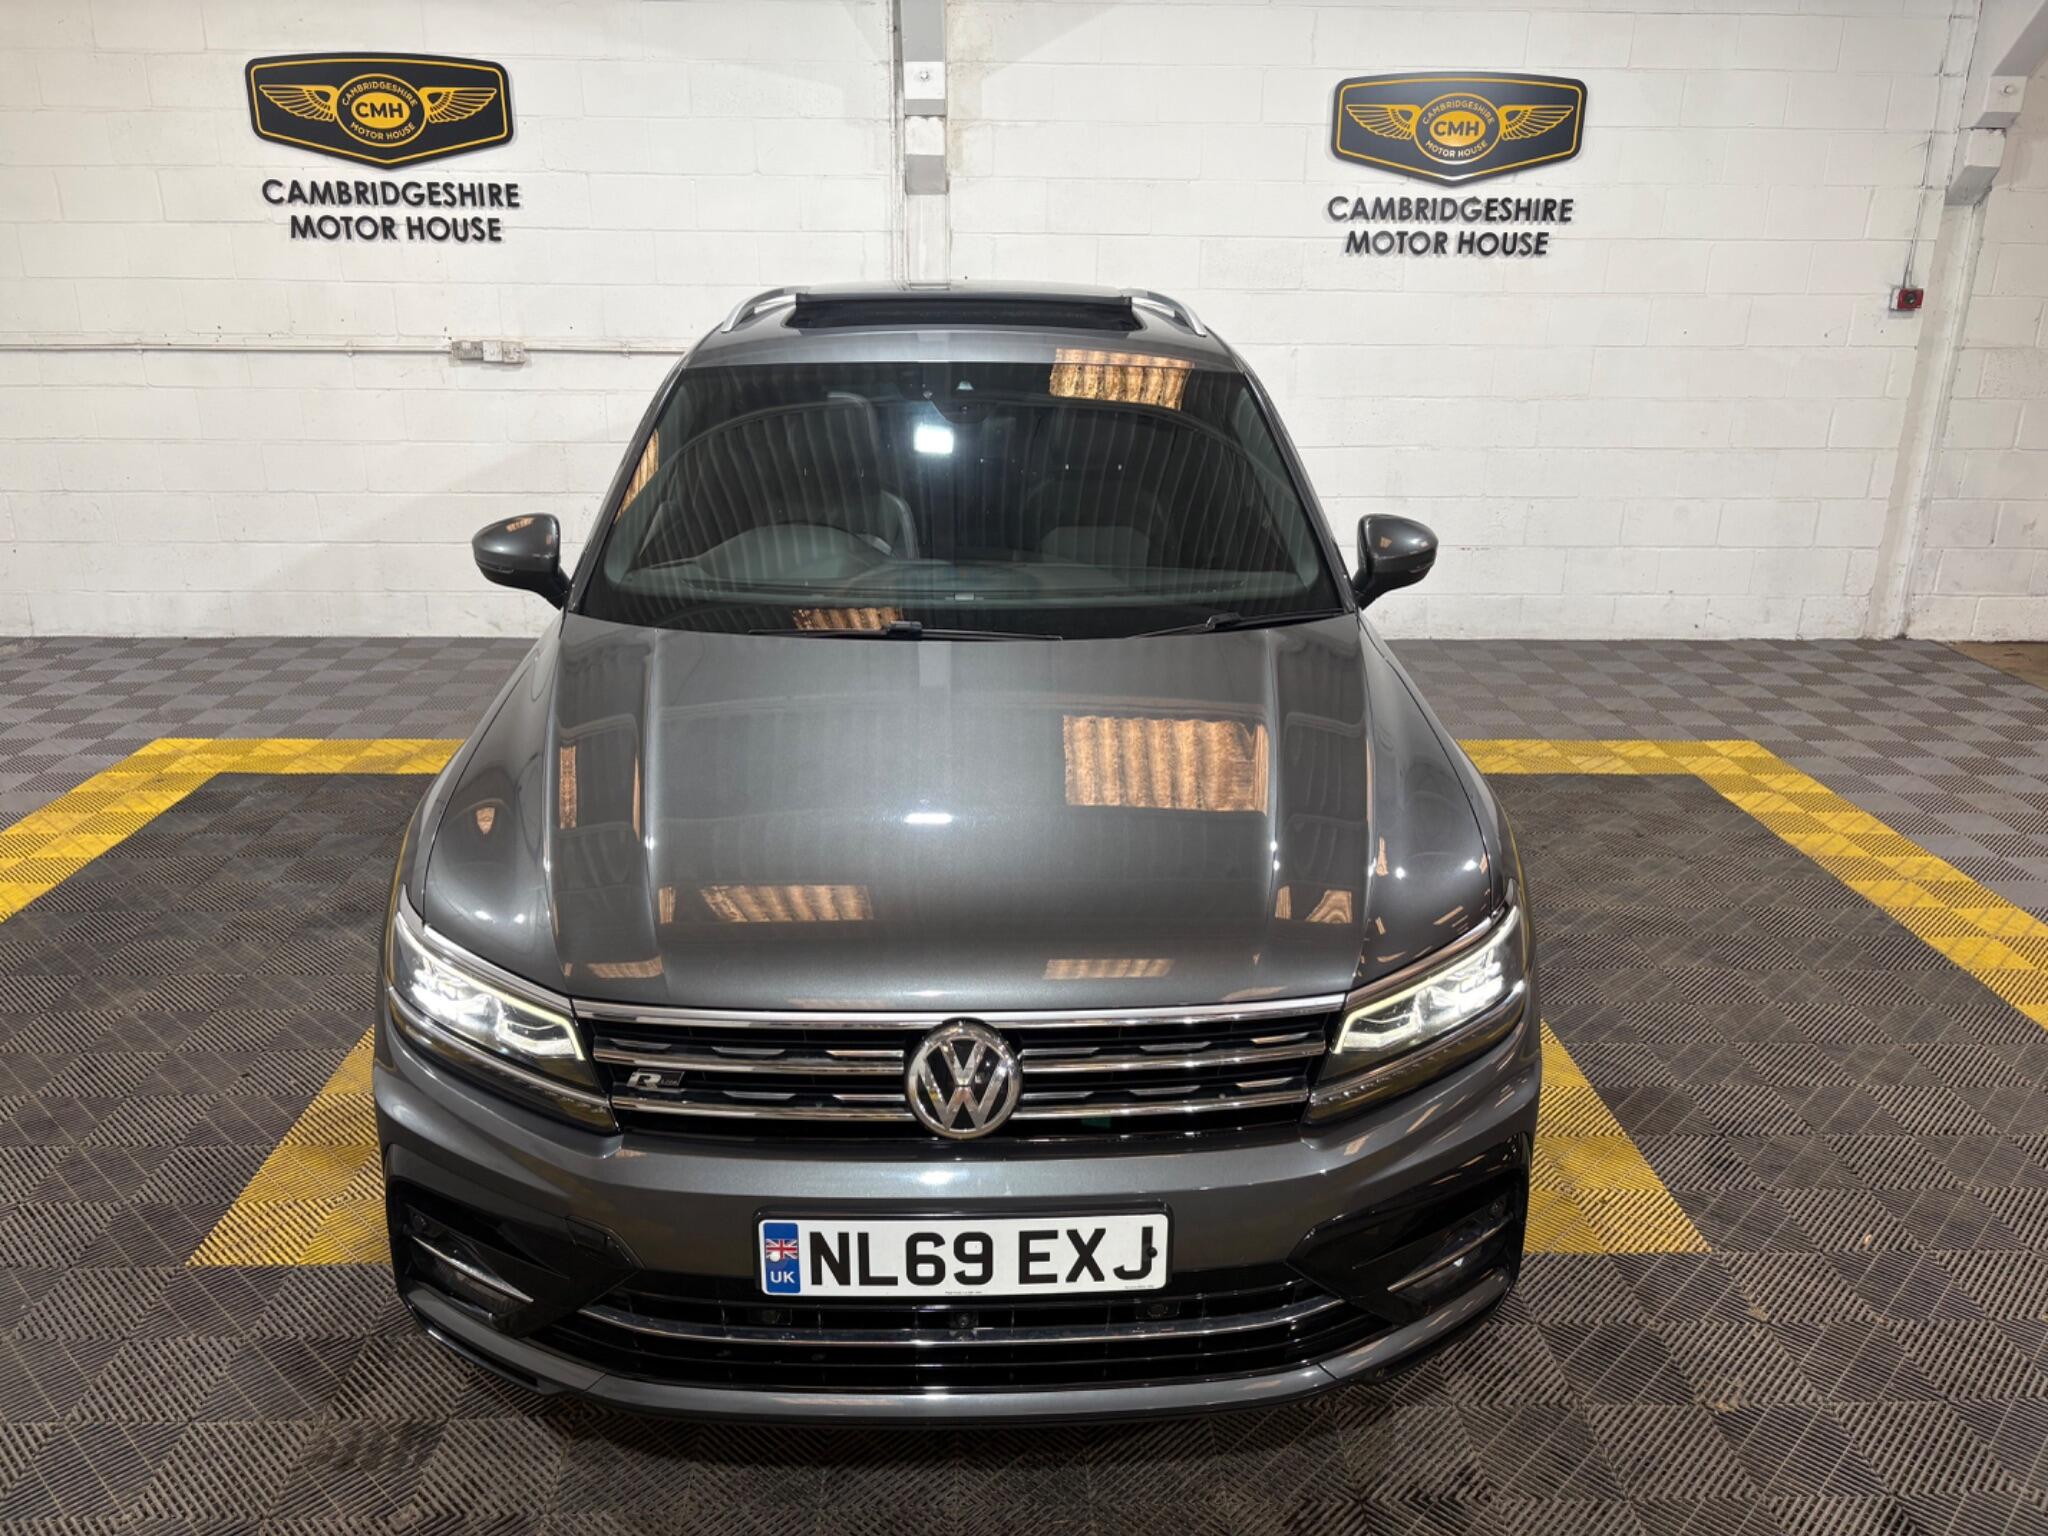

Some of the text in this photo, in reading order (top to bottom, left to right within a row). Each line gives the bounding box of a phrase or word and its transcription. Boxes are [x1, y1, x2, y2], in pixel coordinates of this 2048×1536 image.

[342, 80, 418, 107] CAMBRIDGESHIRE
[355, 101, 404, 119] CMH
[1422, 100, 1496, 125] CAMBRIDGESHIRE
[350, 121, 416, 140] MOTOR HOUSE
[1433, 120, 1480, 137] CMH
[1425, 140, 1488, 158] MOTOR HOUSE
[262, 179, 520, 208] CAMBRIDGESHIRE
[1328, 196, 1574, 223] CAMBRIDGESHIRE
[290, 215, 503, 242] MOTOR HOUSE
[1345, 231, 1549, 256] MOTOR HOUSE
[809, 1226, 1155, 1286] NL69 EXJ
[770, 1270, 796, 1284] UK
